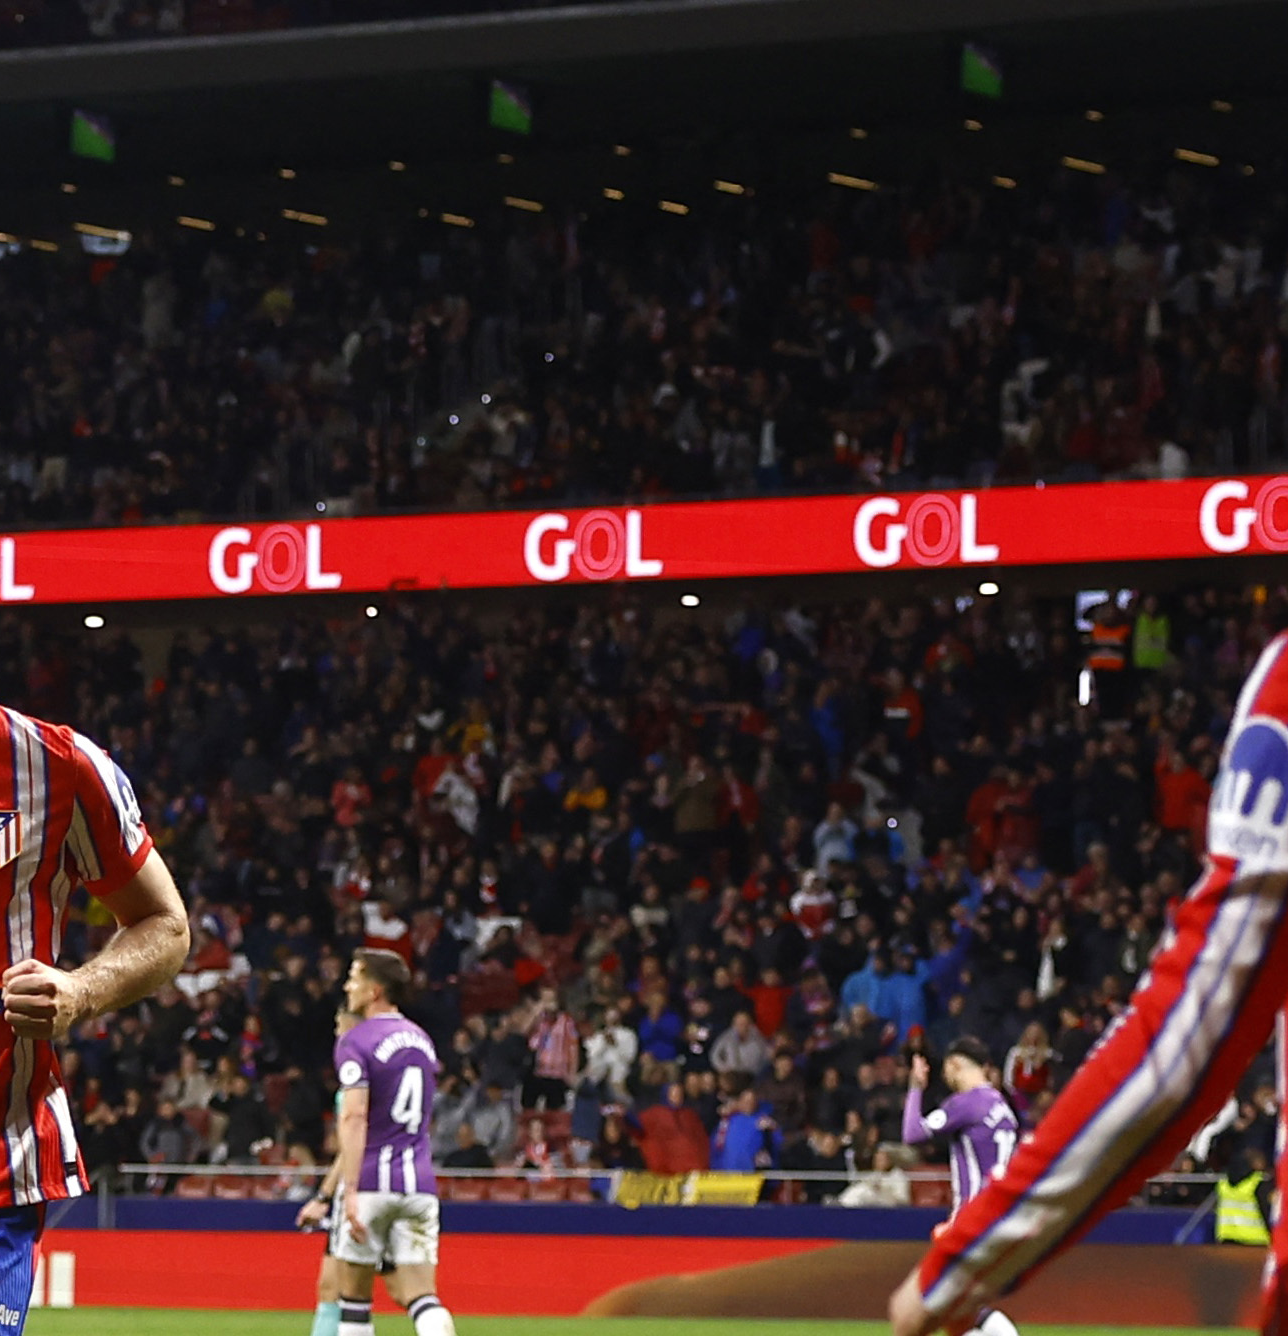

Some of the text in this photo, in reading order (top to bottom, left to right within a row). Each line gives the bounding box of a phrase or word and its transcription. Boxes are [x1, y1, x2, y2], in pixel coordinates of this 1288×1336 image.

[208, 524, 342, 594] GOL
[524, 509, 663, 581] GOL
[853, 493, 1000, 567] GOL
[390, 1065, 424, 1134] 4
